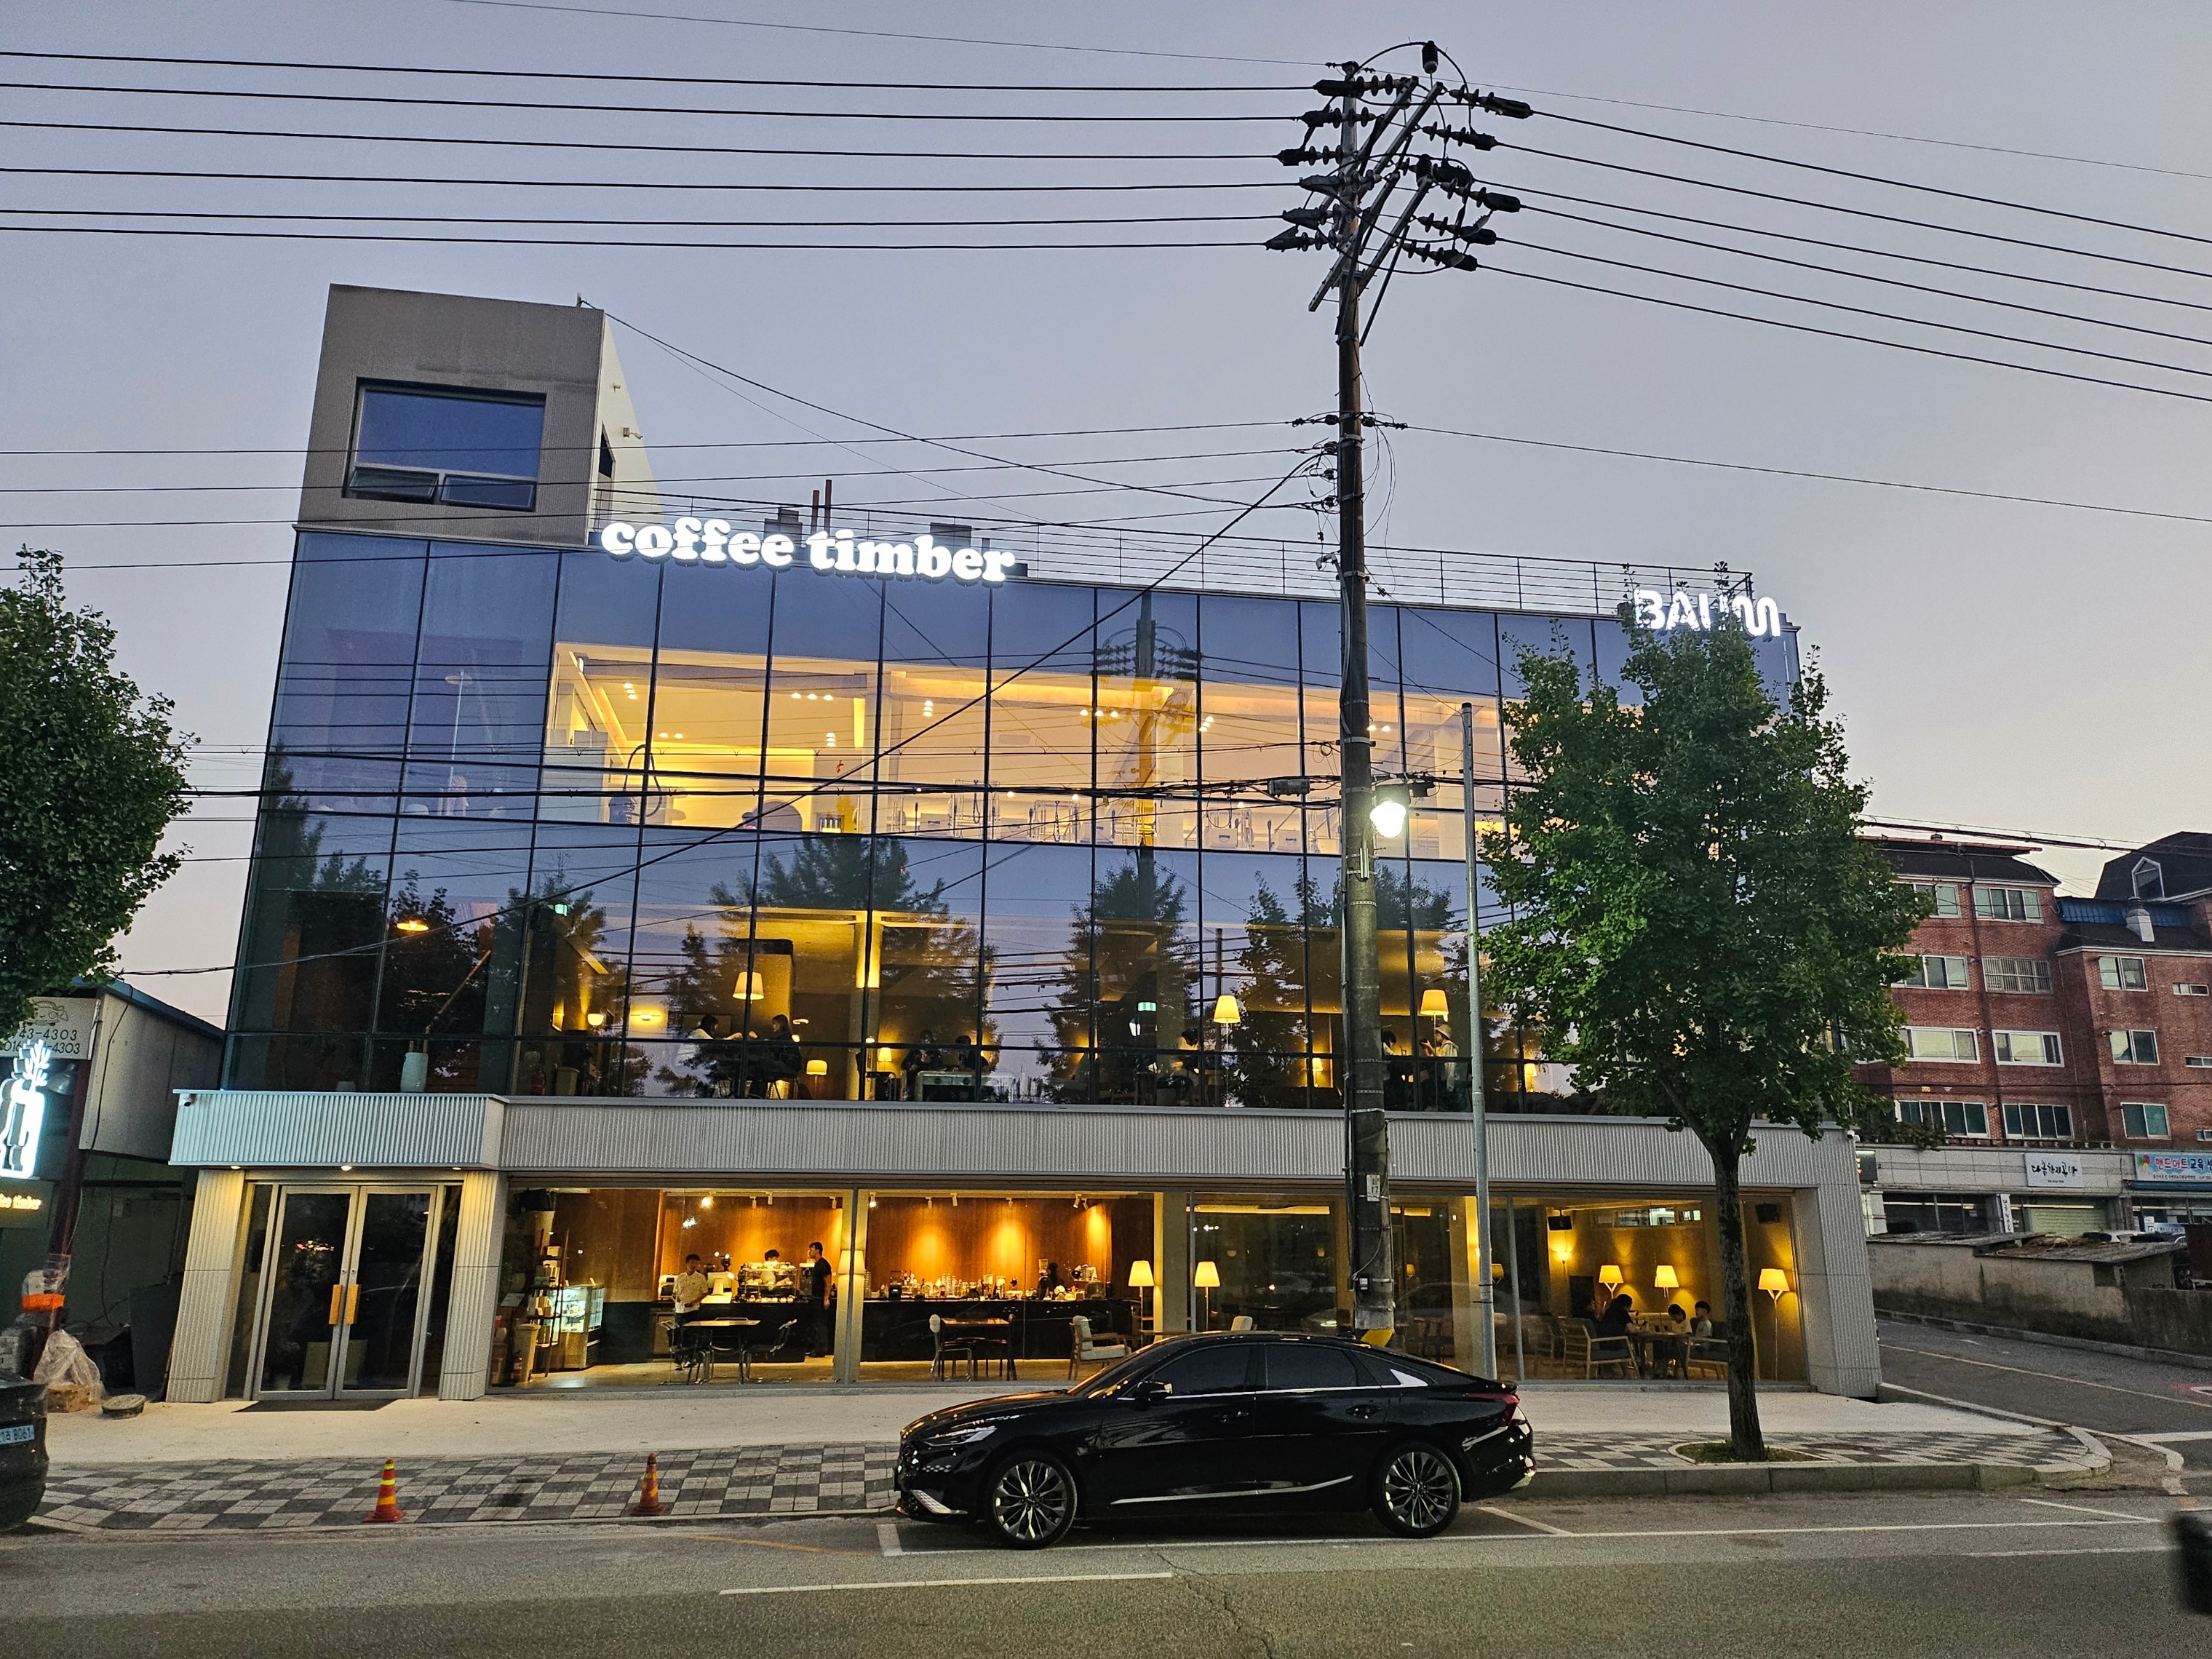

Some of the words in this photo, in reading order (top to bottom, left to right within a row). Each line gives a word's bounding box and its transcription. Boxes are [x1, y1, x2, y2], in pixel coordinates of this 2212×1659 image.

[601, 517, 795, 567] coffee
[806, 529, 1016, 581] timber
[16, 1028, 78, 1041] 43-4303
[2190, 1158, 2204, 1171] 교육
